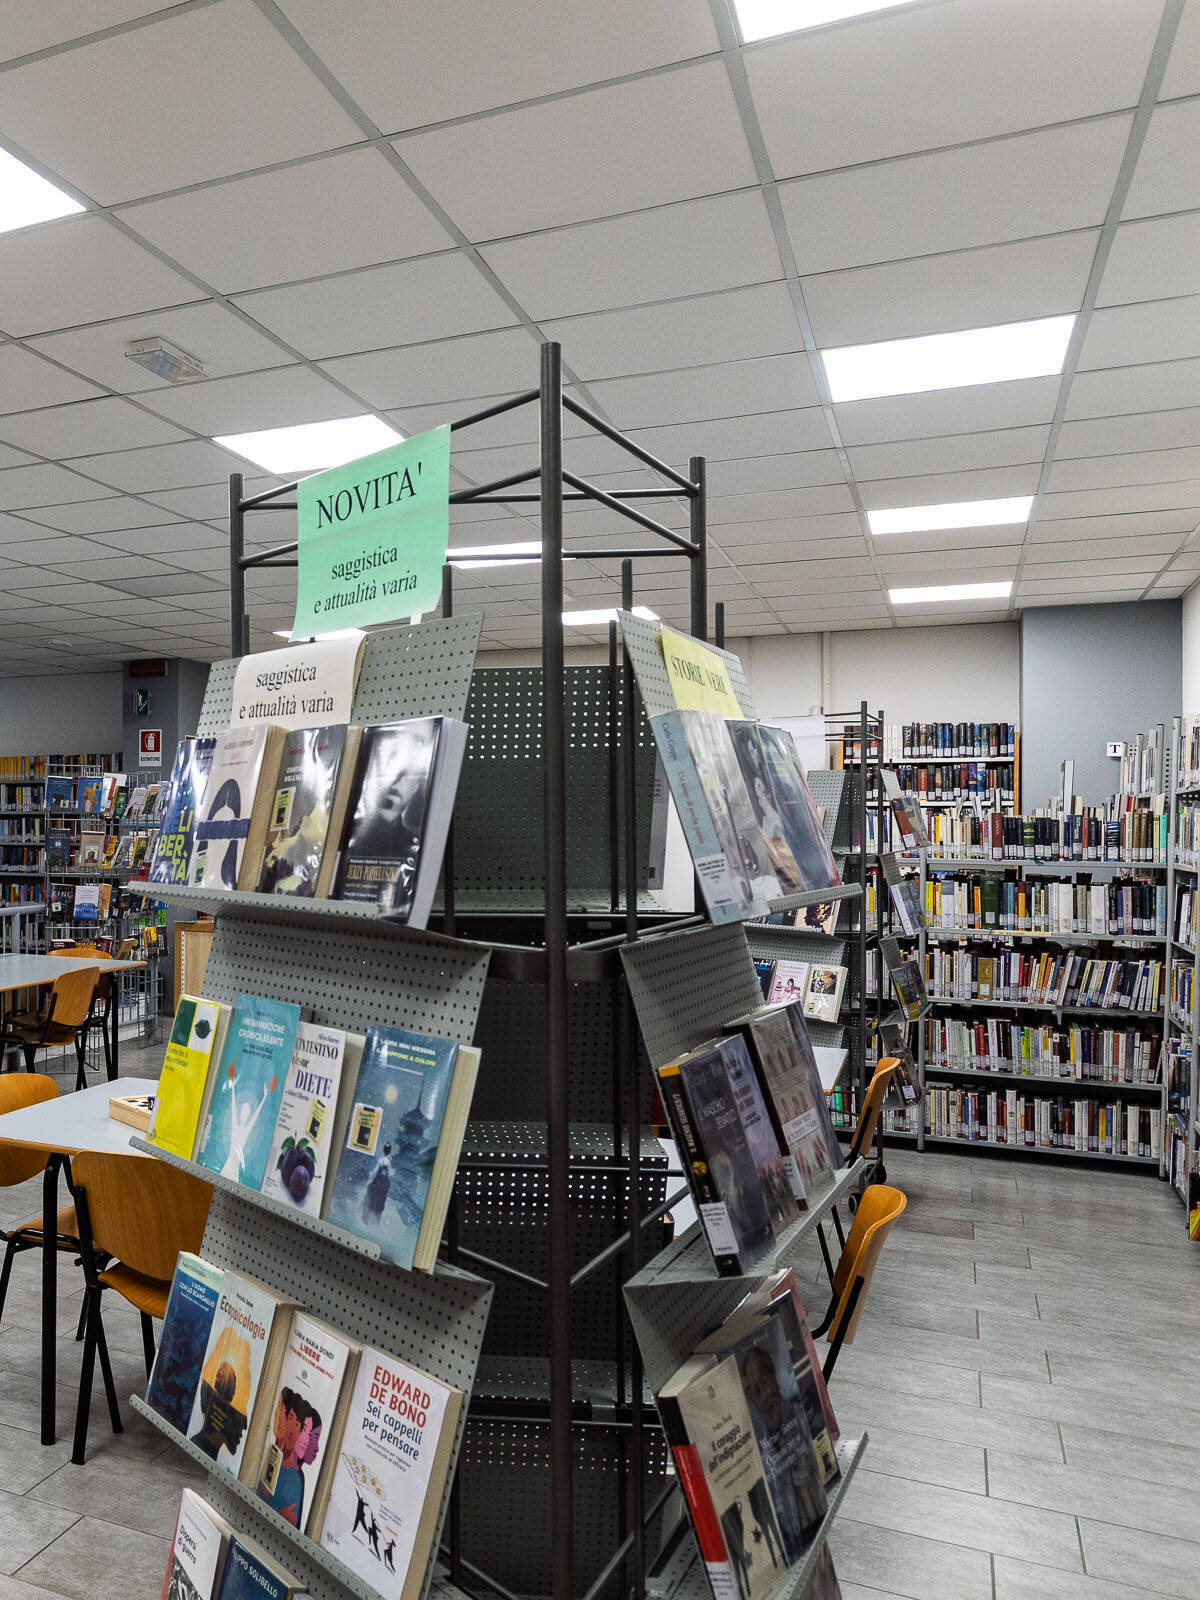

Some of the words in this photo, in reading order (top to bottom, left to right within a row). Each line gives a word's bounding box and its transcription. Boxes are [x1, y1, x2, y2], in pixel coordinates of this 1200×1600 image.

[316, 461, 422, 529] NOVITA'
[331, 546, 398, 581] saggistica
[314, 601, 321, 614] e
[324, 580, 377, 612] attualità
[382, 570, 418, 597] varia
[255, 662, 317, 691] saggistica
[671, 656, 705, 687] STORIE
[239, 706, 246, 719] e
[248, 695, 297, 719] attualità
[301, 691, 334, 713] varia
[1110, 744, 1120, 754] T
[178, 810, 193, 833] LI
[295, 1070, 333, 1099] DIETE
[220, 1294, 266, 1340] Ecopsicologia
[300, 1342, 321, 1363] LIBERE
[373, 1364, 431, 1410] EDWARD
[369, 1382, 388, 1405] DE
[389, 1394, 427, 1428] BONO
[362, 1416, 379, 1434] per
[380, 1428, 420, 1461] pensare
[366, 1400, 382, 1420] Sei
[383, 1413, 423, 1446] cappelli
[248, 1566, 279, 1599] SOLIBELLO
